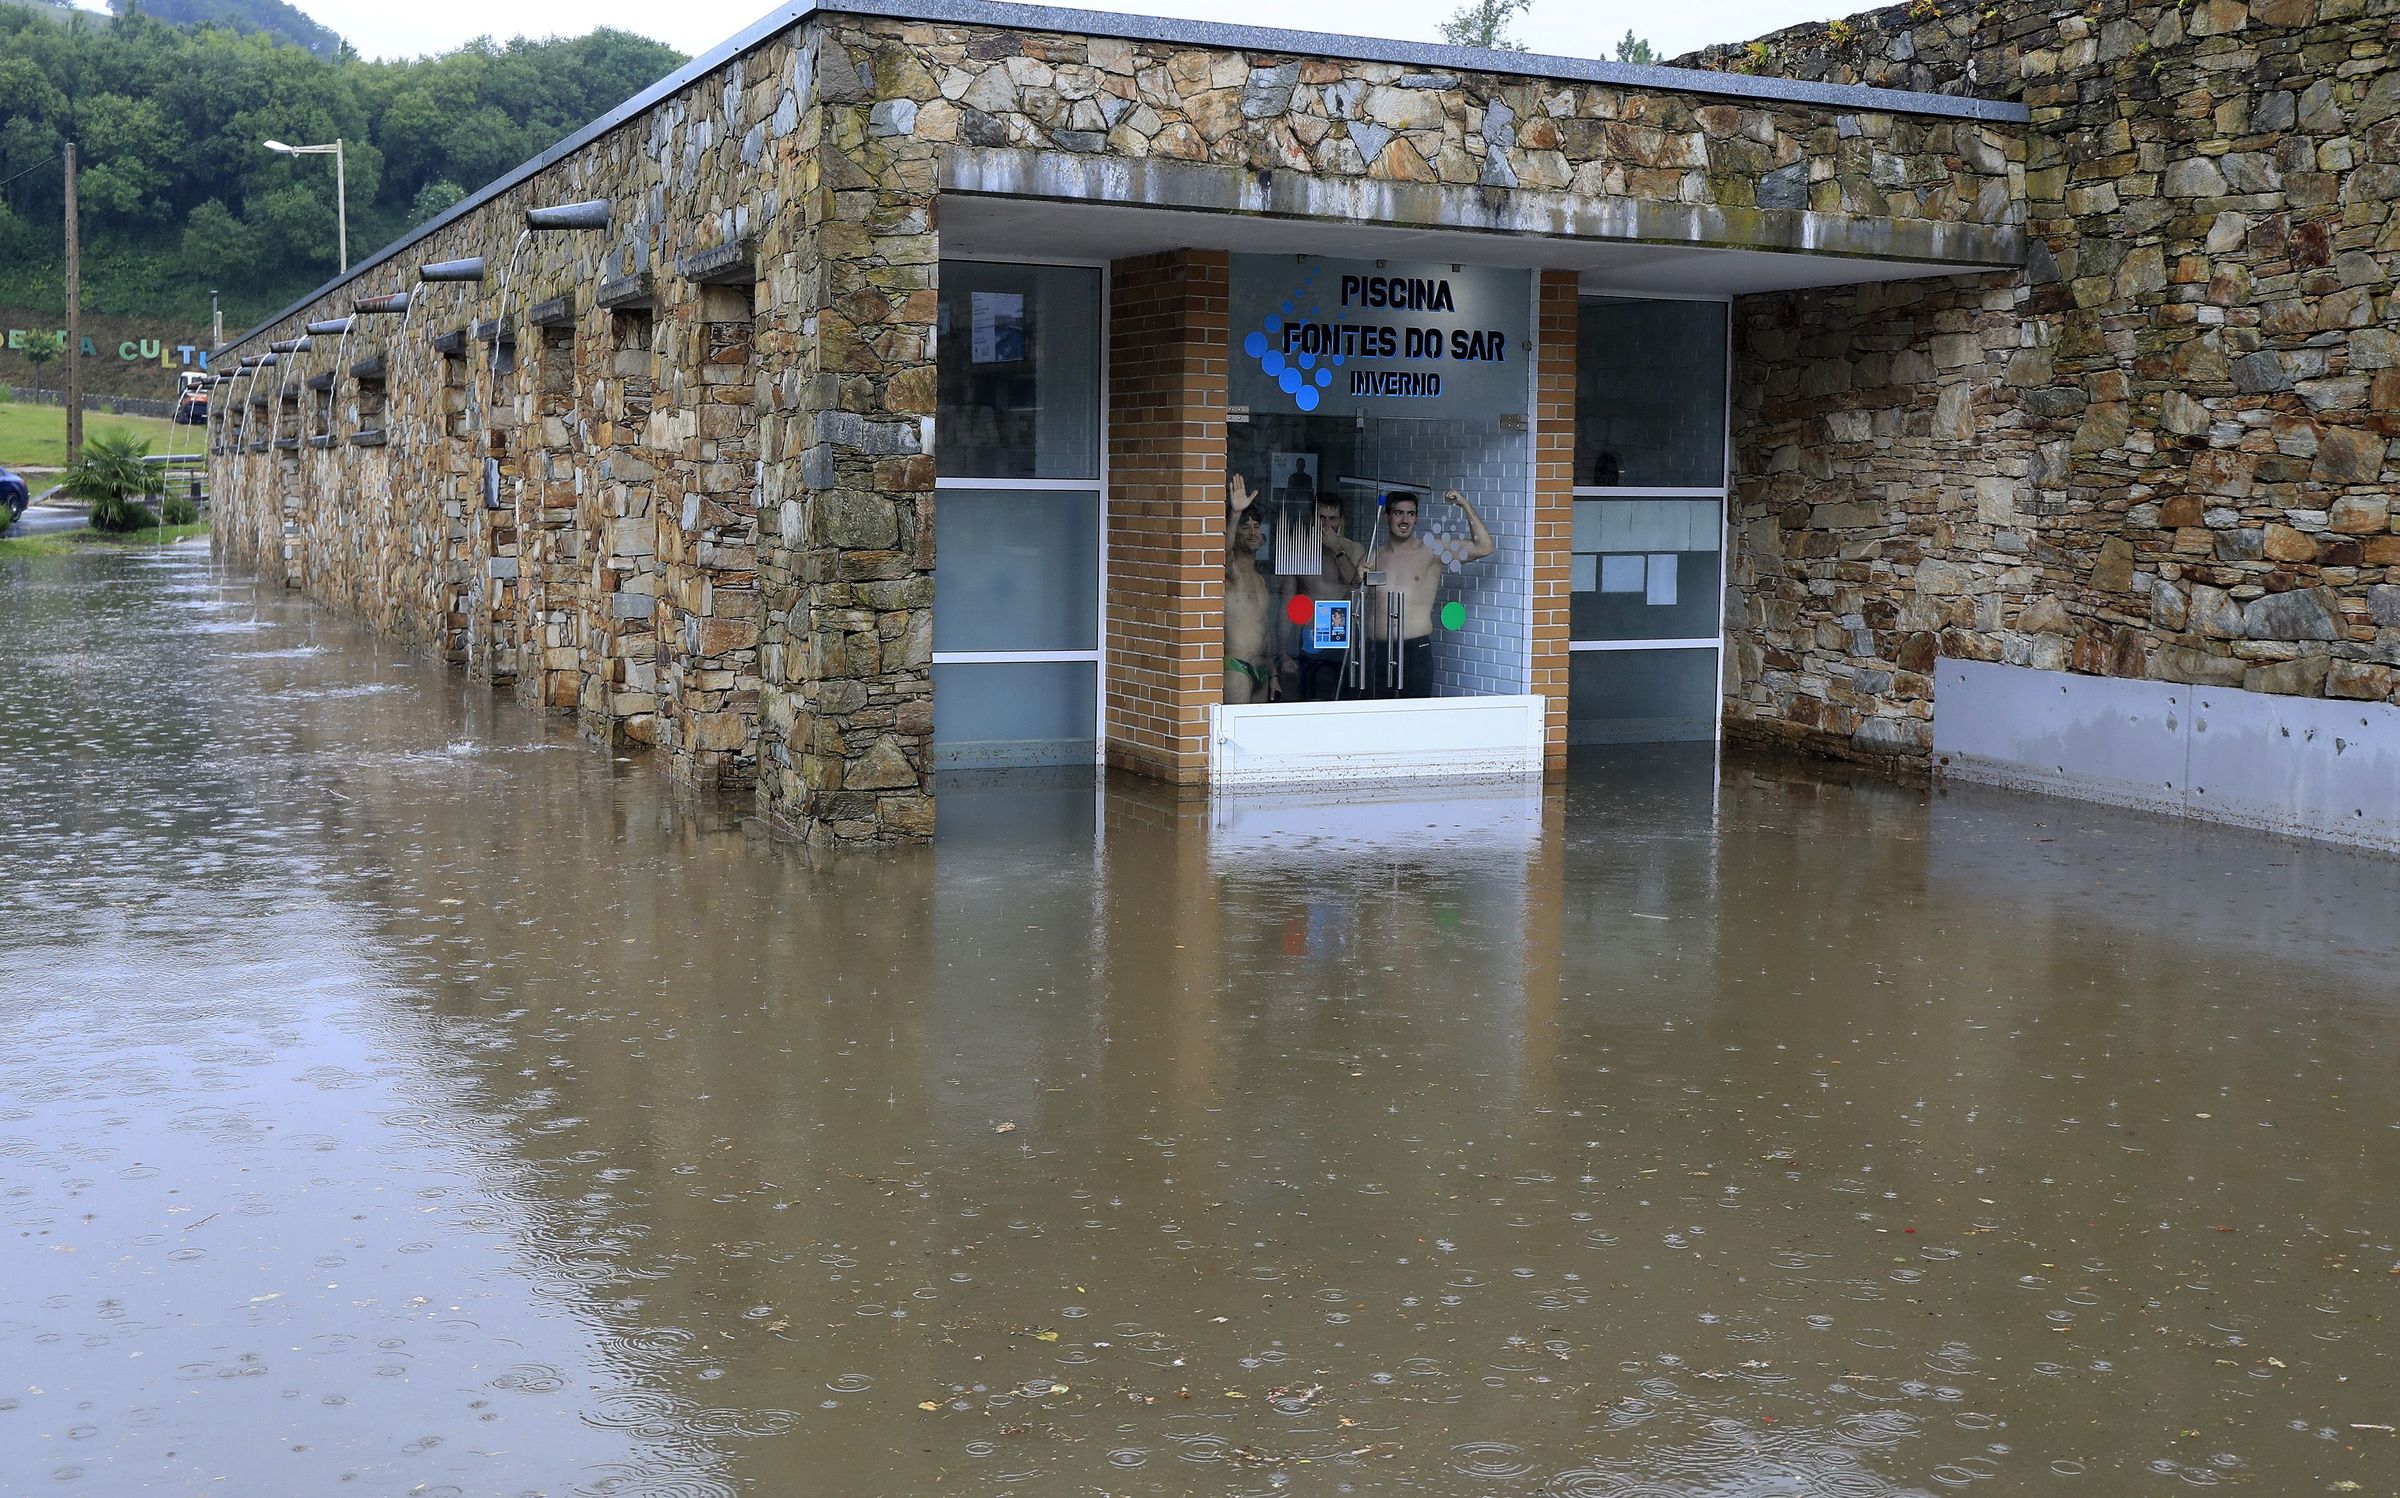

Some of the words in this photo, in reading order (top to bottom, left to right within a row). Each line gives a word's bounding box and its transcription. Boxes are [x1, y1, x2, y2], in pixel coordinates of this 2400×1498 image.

[1341, 275, 1455, 312] PISCINA
[1283, 322, 1398, 358] FONTES
[1405, 327, 1443, 359] DO
[1450, 329, 1505, 362] SAR
[1350, 371, 1442, 397] INVERNO
